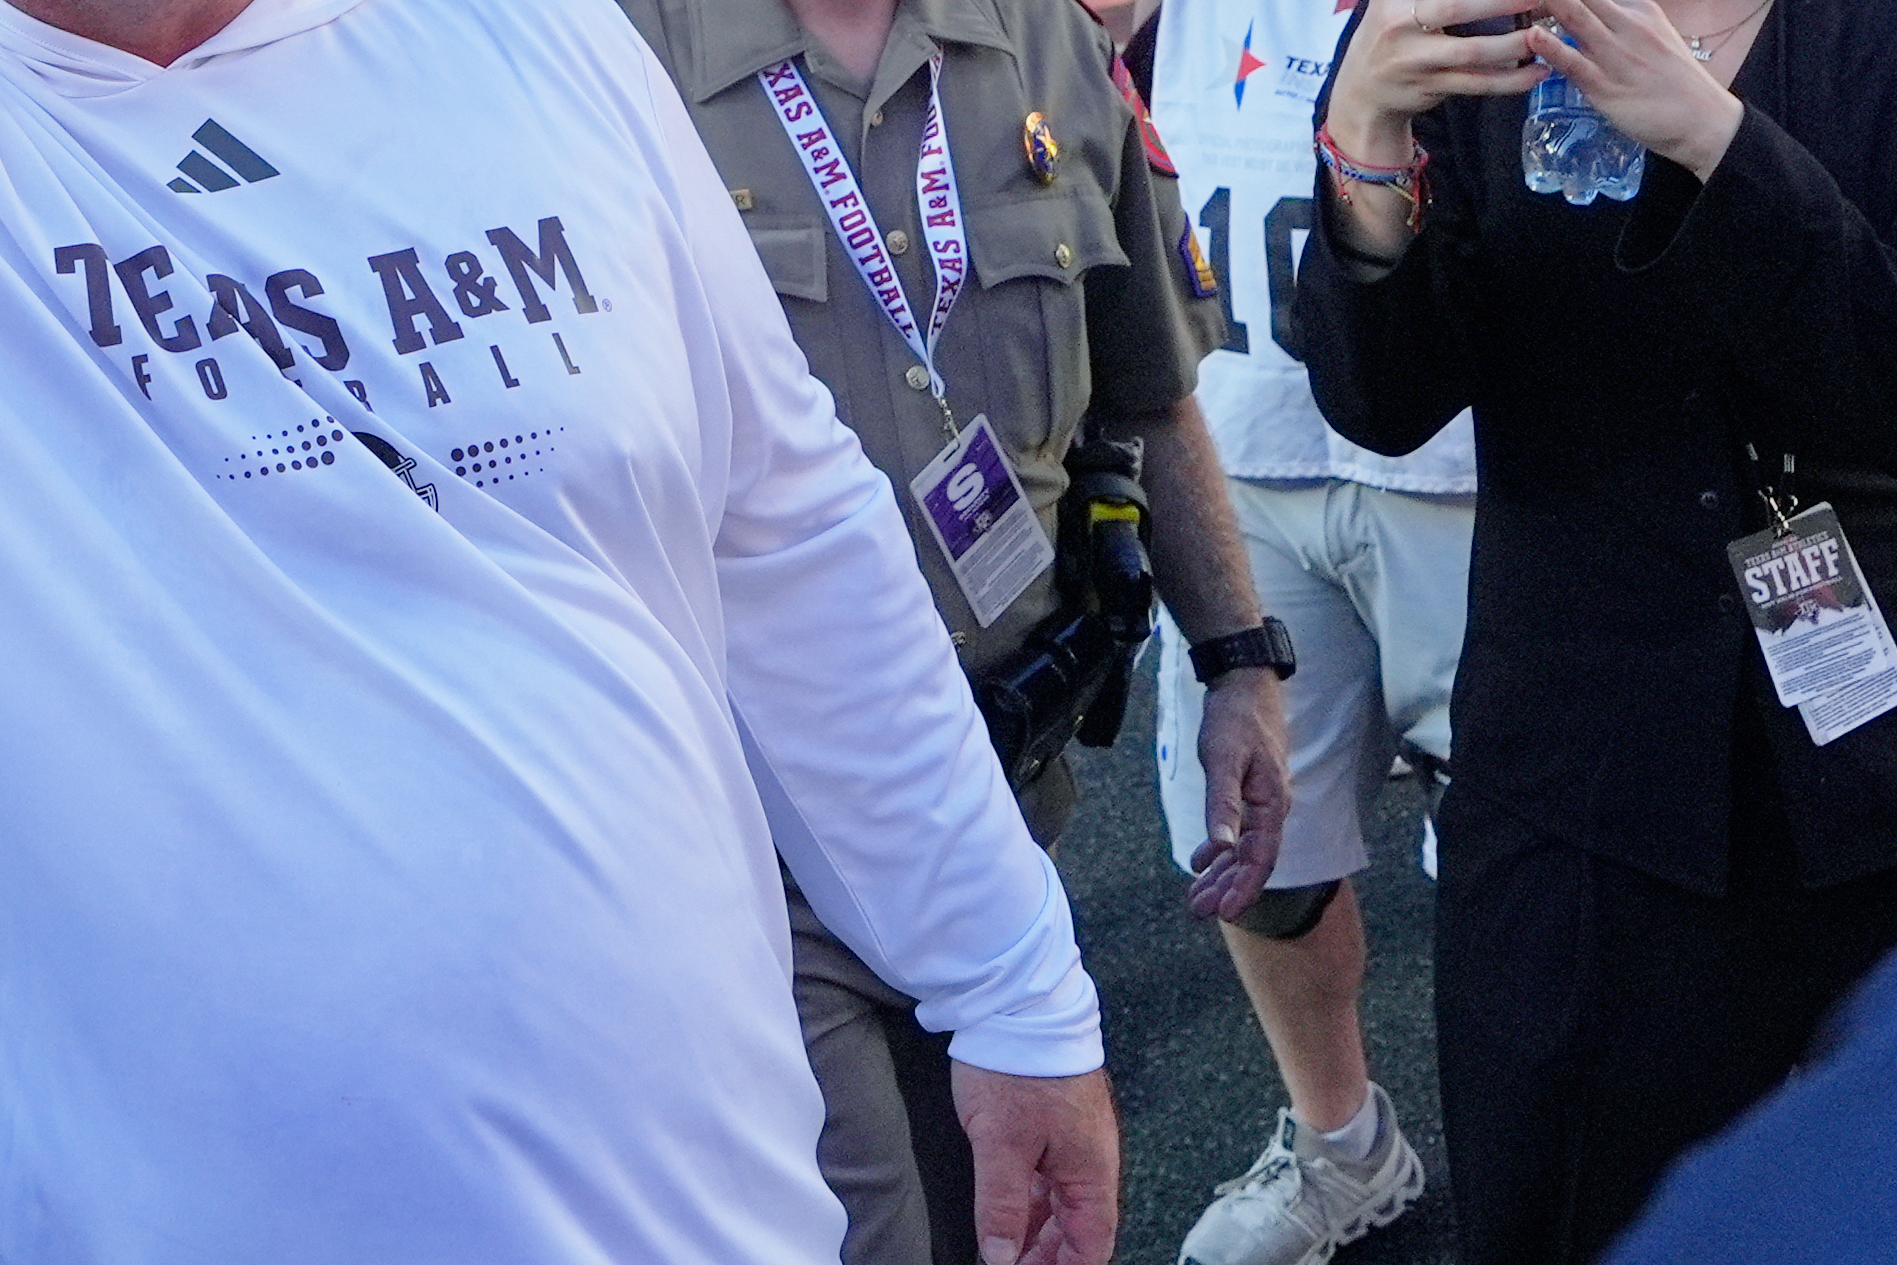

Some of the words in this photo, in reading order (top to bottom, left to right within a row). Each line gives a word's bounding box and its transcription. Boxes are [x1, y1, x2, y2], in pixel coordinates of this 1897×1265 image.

[1286, 55, 1332, 77] TEXA
[763, 62, 813, 123] XAS
[829, 190, 918, 340] FOOTBALL
[931, 239, 963, 336] TEXAS
[946, 462, 985, 512] S
[1744, 537, 1839, 604] STAFF
